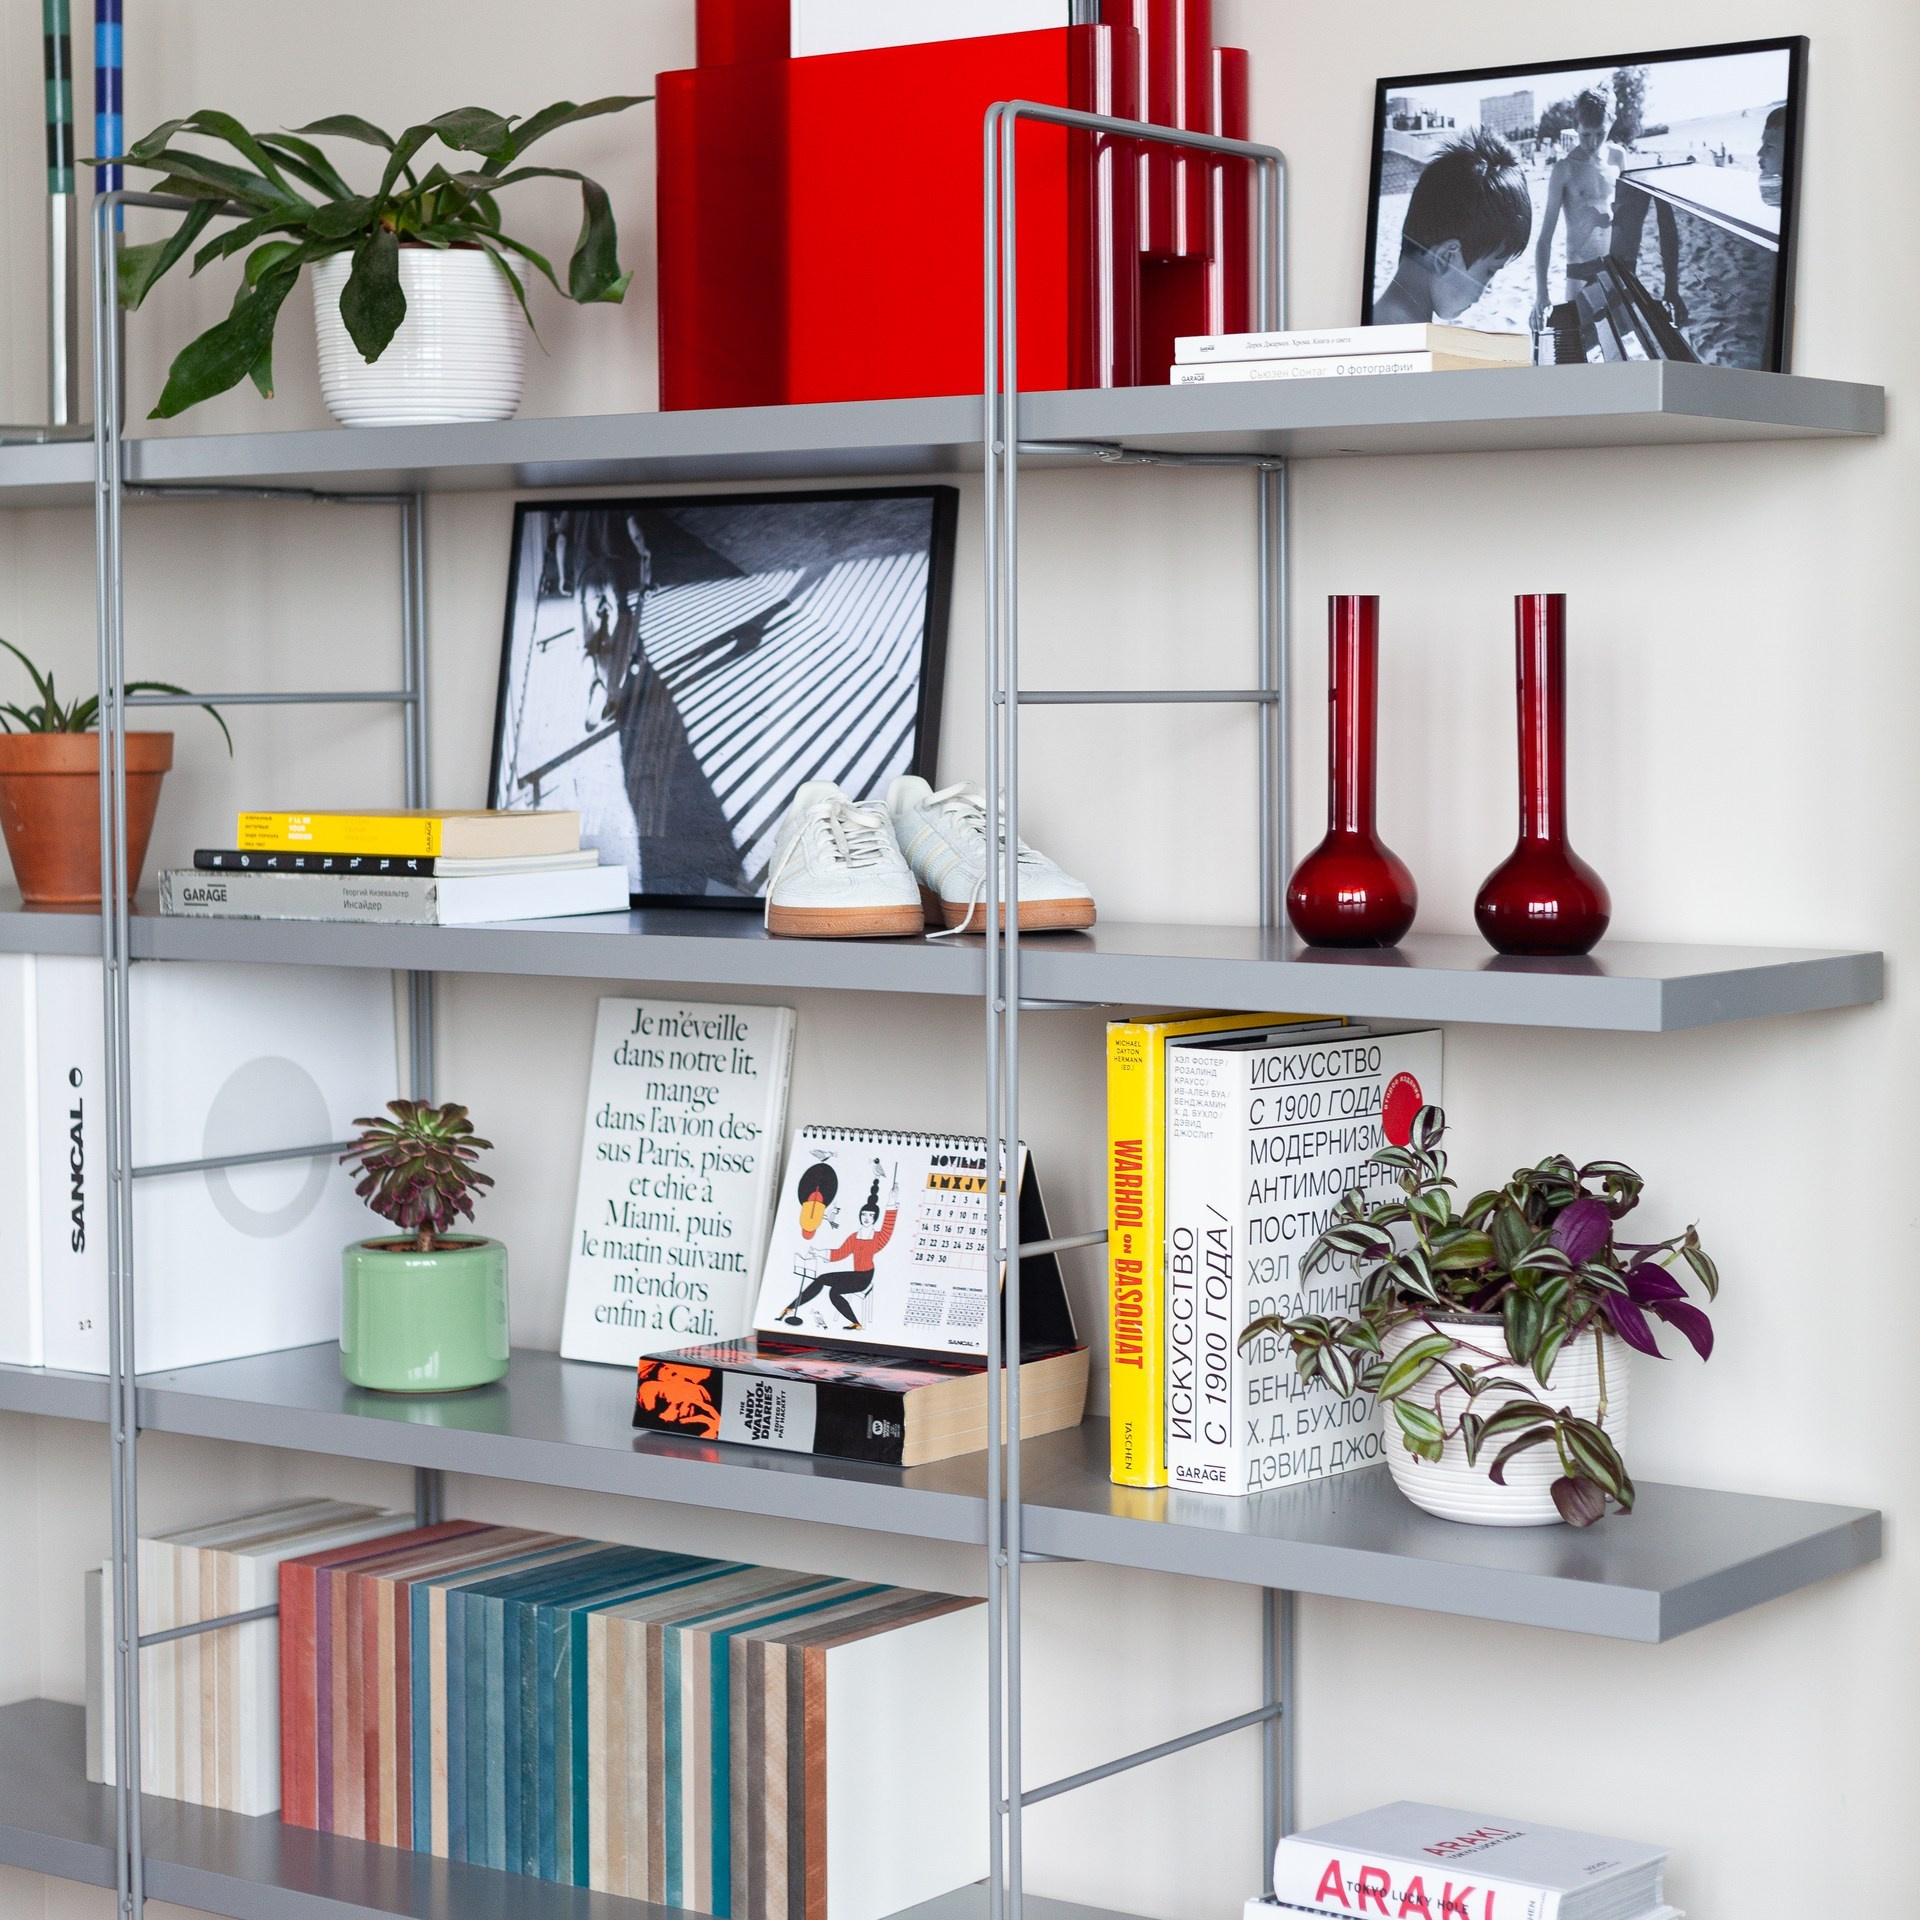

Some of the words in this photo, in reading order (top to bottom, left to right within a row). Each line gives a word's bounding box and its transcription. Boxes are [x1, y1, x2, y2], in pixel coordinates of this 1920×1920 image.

[1245, 341, 1262, 349] Дерек
[1181, 373, 1205, 382] GARAGE
[1250, 368, 1289, 379] Сьюзен
[1291, 367, 1327, 377] Сонтаг
[1336, 364, 1345, 375] О
[1347, 362, 1413, 376] фотографии
[425, 821, 433, 852] GARAGE
[183, 885, 227, 904] GARAGE
[342, 887, 368, 898] Георгий
[368, 887, 410, 898] Кизевальтер
[343, 900, 382, 911] Инсайдер
[631, 1007, 654, 1035] Je
[658, 1010, 748, 1041] m’éveille
[613, 1040, 665, 1069] dans
[669, 1051, 727, 1073] notre
[731, 1047, 757, 1079] lit,
[1116, 1047, 1140, 1055] DAYTON
[1174, 1056, 1190, 1064] ХЭЛ
[1251, 1045, 1382, 1085] ИСКУССТВО
[1174, 1066, 1217, 1078] РОЗАЛИНД
[646, 1081, 720, 1113] mange
[1174, 1087, 1209, 1097] ИВ-АЛЕН
[1174, 1097, 1226, 1109] БЕНДЖАМИН
[1249, 1098, 1266, 1126] С
[1275, 1092, 1321, 1123] 1900
[1328, 1084, 1382, 1117] ГОДА
[595, 1102, 646, 1133] dans
[649, 1106, 714, 1138] l’avion
[718, 1113, 763, 1141] des-
[1174, 1119, 1202, 1129] ДЭВИД
[1174, 1129, 1214, 1139] ДЖОСЛИТ
[596, 1142, 631, 1162] sus
[700, 1145, 755, 1178] pisse
[1250, 1124, 1385, 1167] МОДЕРНИЗМ
[69, 1097, 86, 1254] SANCAL
[930, 1154, 1002, 1171] NOVIEMB
[628, 1176, 651, 1197] et
[653, 1173, 697, 1201] chie
[701, 1177, 713, 1203] à
[965, 1178, 973, 1190] J
[977, 1178, 987, 1191] V
[1114, 1139, 1143, 1231] WARHOL
[1248, 1158, 1434, 1205] АНТИМОДЕРНИ
[937, 1209, 942, 1217] 8
[949, 1210, 954, 1218] 9
[960, 1211, 967, 1219] 10
[972, 1212, 978, 1220] 11
[952, 1195, 957, 1203] 2
[964, 1196, 969, 1204] 3
[976, 1197, 980, 1205] 4
[685, 1211, 732, 1242] puis
[921, 1223, 929, 1231] 14
[933, 1224, 940, 1232] 15
[944, 1225, 952, 1233] 16
[957, 1226, 964, 1234] 17
[968, 1227, 976, 1235] 18
[980, 1228, 988, 1236] 19
[580, 1230, 599, 1257] le
[602, 1237, 662, 1264] matin
[666, 1241, 749, 1275] suivant,
[915, 1253, 923, 1261] 28
[926, 1254, 935, 1262] 29
[938, 1255, 947, 1263] 30
[918, 1238, 926, 1246] 21
[929, 1239, 938, 1247] 22
[941, 1240, 949, 1248] 23
[953, 1241, 961, 1249] 24
[965, 1242, 973, 1251] 25
[976, 1243, 985, 1251] 26
[1123, 1234, 1132, 1254] ON
[613, 1268, 709, 1302] m’endors
[1247, 1254, 1289, 1286] ХЭЛ
[594, 1299, 646, 1329] enfin
[651, 1304, 663, 1330] à
[668, 1304, 719, 1337] Cali.
[1114, 1259, 1143, 1370] BASQUIAT
[1249, 1282, 1362, 1323] РОЗАЛИНД
[948, 1339, 974, 1347] SANCAL
[1172, 1227, 1194, 1440] ИСКУССТВО
[1206, 1332, 1228, 1404] 1900
[744, 1389, 755, 1430] ANDY
[752, 1380, 764, 1440] WARHOL
[761, 1385, 773, 1440] DIARIES
[776, 1395, 781, 1406] BY
[1204, 1421, 1227, 1445] С
[1247, 1420, 1264, 1446] Х.
[1269, 1414, 1290, 1447] Д.
[1176, 1464, 1226, 1483] GARAGE
[1247, 1445, 1323, 1492] ДЭВИД
[1329, 1430, 1386, 1474] ДЖОС
[1422, 1826, 1510, 1857] ARAKI
[1446, 1848, 1478, 1860] TOKYO
[1476, 1839, 1502, 1852] LUCKY
[1502, 1831, 1527, 1843] HOLE
[1315, 1859, 1496, 1920] ARAKI
[1346, 1881, 1388, 1898] TOKYO
[1392, 1890, 1432, 1908] LUCKY
[1437, 1899, 1469, 1915] HOLE
